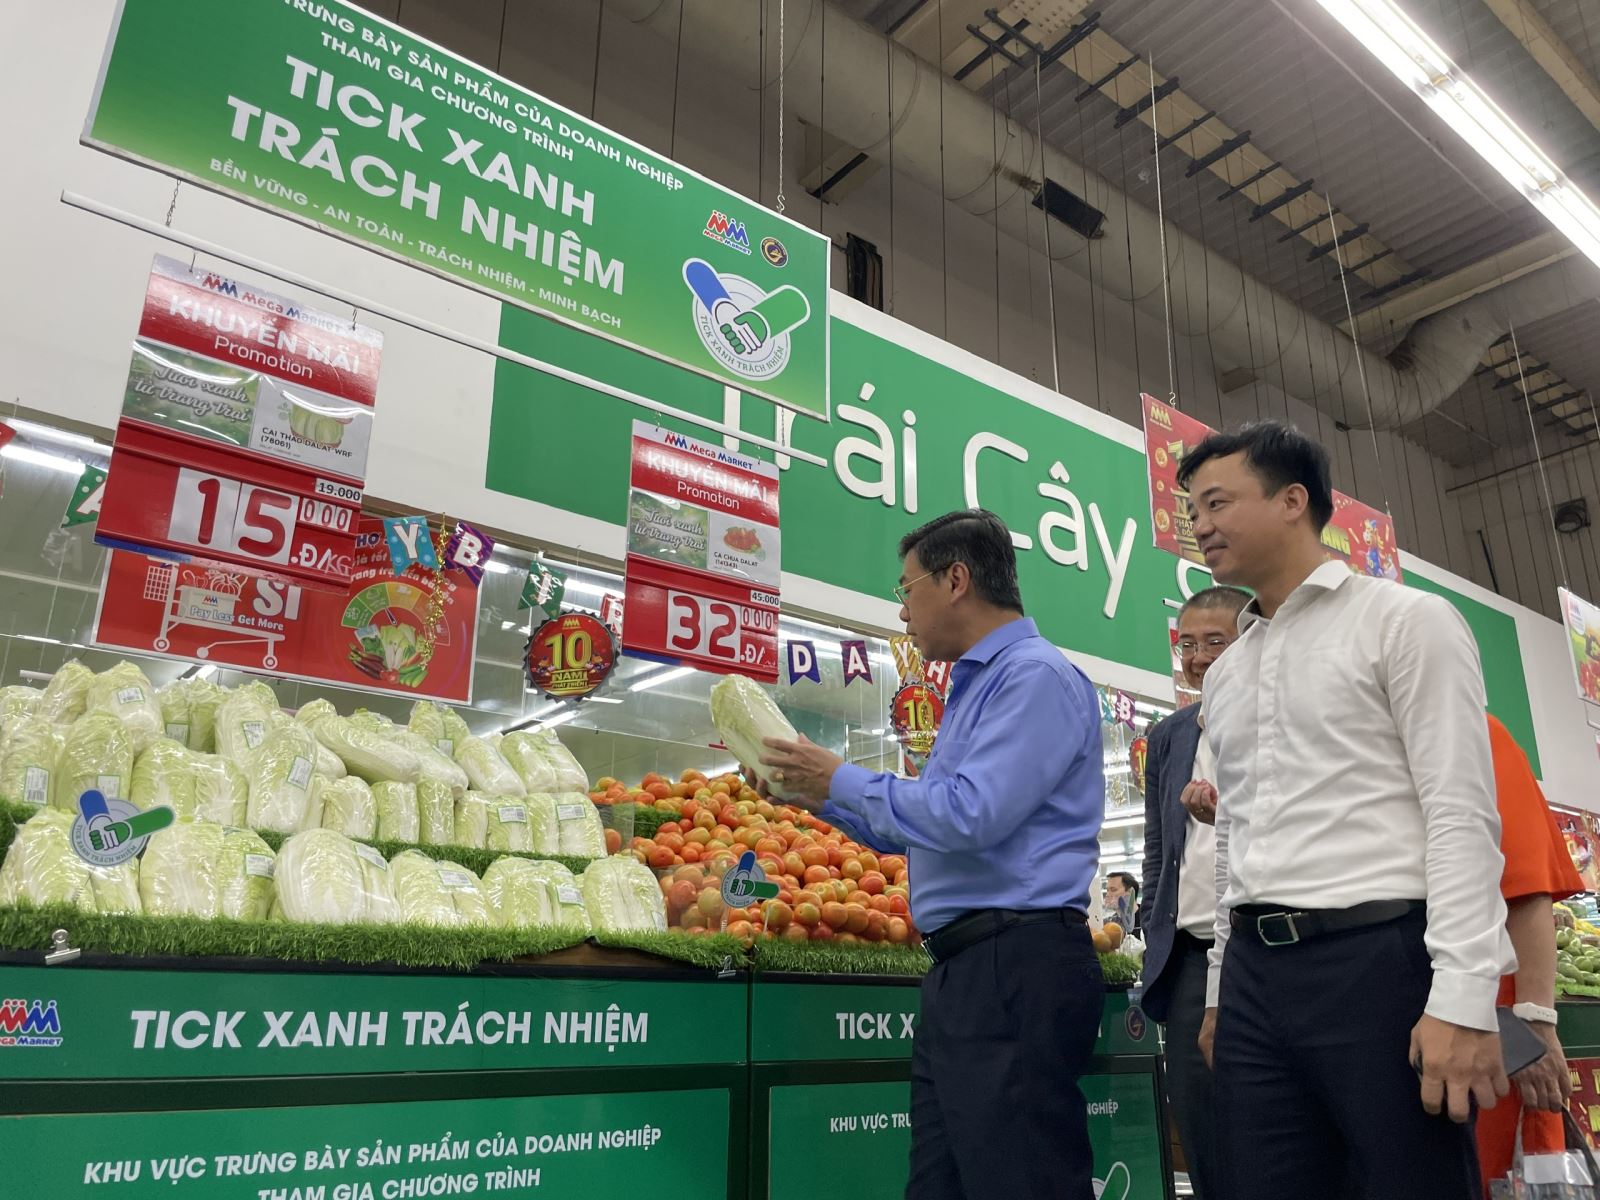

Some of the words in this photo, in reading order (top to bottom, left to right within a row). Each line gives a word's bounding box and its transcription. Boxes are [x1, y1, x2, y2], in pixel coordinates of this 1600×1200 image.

[321, 31, 381, 71] THAM
[387, 65, 424, 92] GIA
[431, 85, 518, 134] CHƯƠNG
[523, 127, 574, 161] TRÌNH
[361, 28, 403, 56] BÀY
[407, 51, 448, 79] SẢN
[454, 72, 509, 109] PHẨM
[514, 101, 553, 130] CỦA
[558, 122, 621, 162] DOANH
[625, 155, 684, 191] NGHIỆP
[286, 54, 426, 153] TICK
[441, 128, 595, 226] XANH
[227, 94, 441, 221] TRÁCH
[460, 195, 625, 296] NHIỆM
[210, 158, 247, 183] BỀN
[253, 175, 308, 206] VỮNG
[324, 205, 350, 223] AN
[356, 215, 404, 245] TOÀN
[418, 240, 472, 271] TRÁCH
[477, 263, 526, 292] NHIỆM
[539, 287, 577, 312] MINH
[581, 303, 621, 329] BẠCH
[214, 335, 313, 379] Promotion
[318, 482, 361, 501] 19.000
[677, 480, 740, 510] Promotion
[393, 524, 419, 559] Y
[963, 431, 1137, 619] Cây
[453, 531, 482, 568] B
[752, 592, 779, 606] 45.000
[238, 614, 255, 625] Get
[258, 619, 284, 631] More
[544, 630, 592, 670] 10
[792, 644, 812, 673] D
[847, 646, 867, 674] A
[895, 641, 909, 668] Y
[903, 699, 934, 731] 10
[131, 1010, 246, 1049] TICK
[257, 1010, 389, 1047] XANH
[402, 1000, 532, 1046] TRÁCH
[543, 1003, 649, 1052] NHIỆM
[835, 1012, 892, 1039] TICK
[830, 1115, 857, 1132] KHU
[861, 1112, 888, 1134] VỰC
[83, 1160, 141, 1184] KHU
[151, 1155, 207, 1185] VỰC
[214, 1151, 297, 1177] TRƯNG
[304, 1144, 351, 1171] BÀY
[356, 1139, 402, 1168] SẢN
[408, 1131, 470, 1163] PHẨM
[476, 1132, 519, 1158] CỦA
[524, 1132, 593, 1154] DOANH
[598, 1124, 662, 1150] NGHIỆP
[332, 1183, 374, 1200] GIA
[381, 1173, 479, 1200] CHƯƠNG
[485, 1165, 541, 1190] TRÌNH
